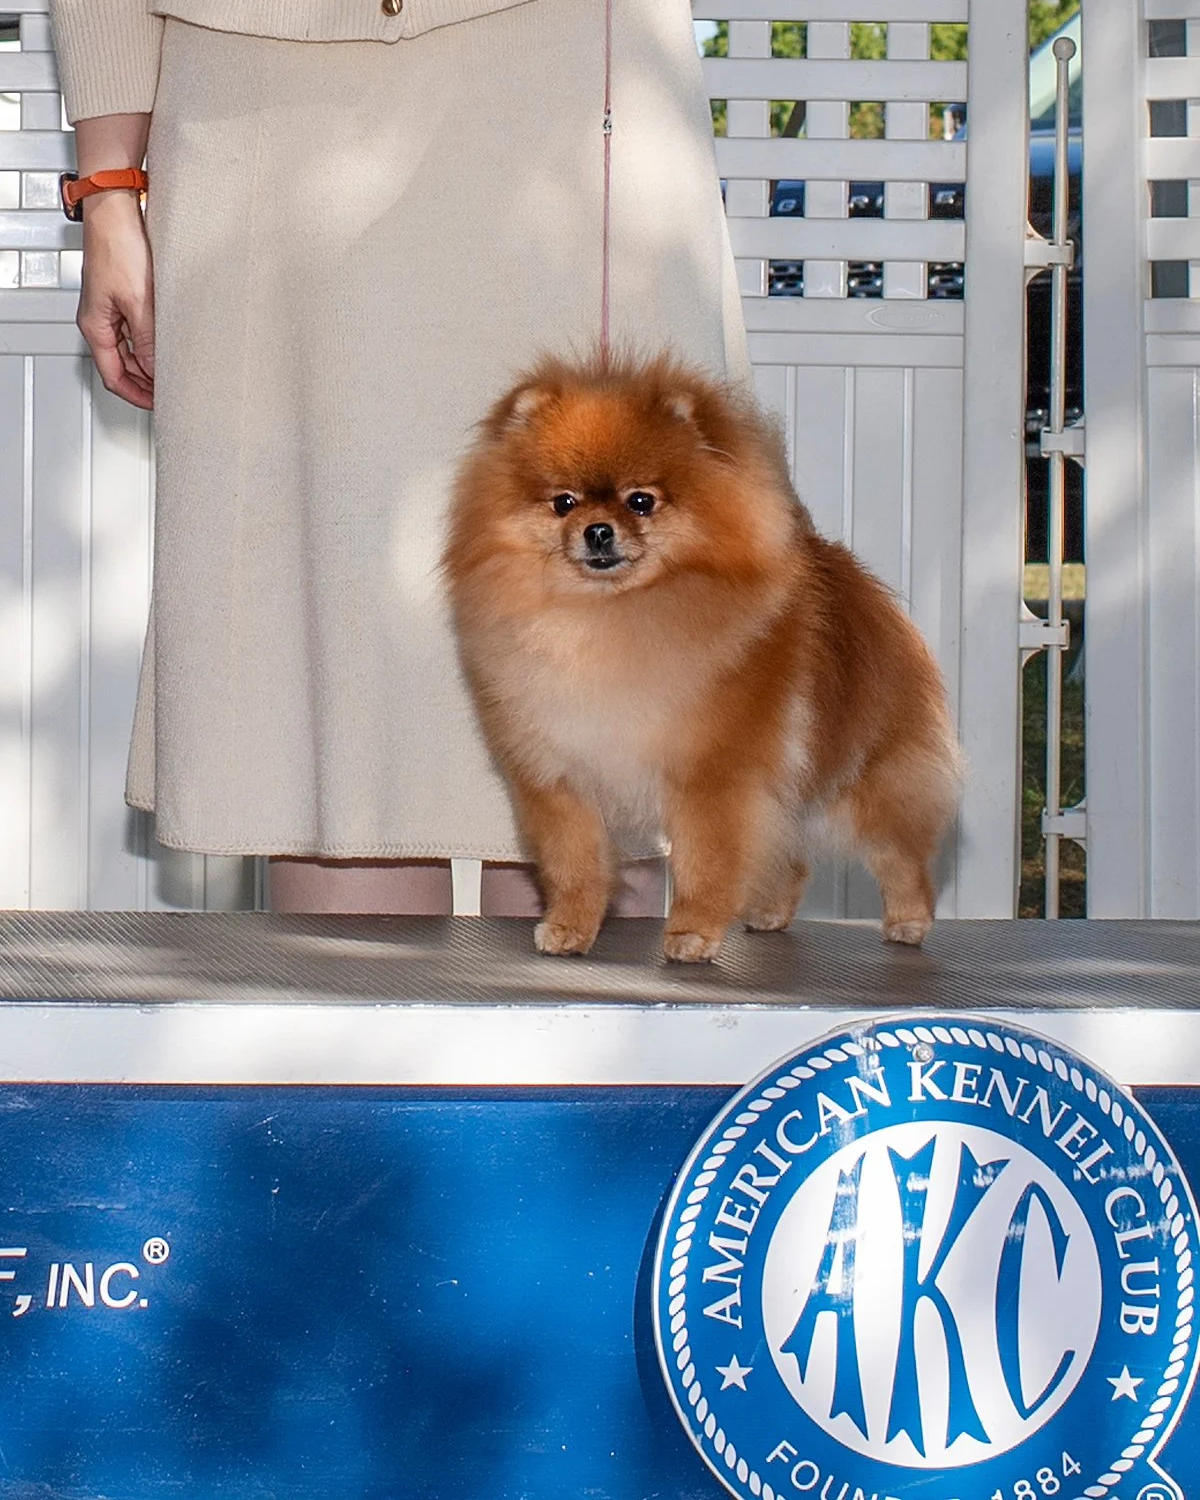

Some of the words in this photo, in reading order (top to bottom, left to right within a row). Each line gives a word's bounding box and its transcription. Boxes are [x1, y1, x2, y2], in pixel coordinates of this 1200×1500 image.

[702, 1066, 893, 1330] AMERICAN
[907, 1059, 1116, 1186] KENNEL
[1103, 1185, 1161, 1335] CLUB
[779, 1134, 1078, 1458] AKC
